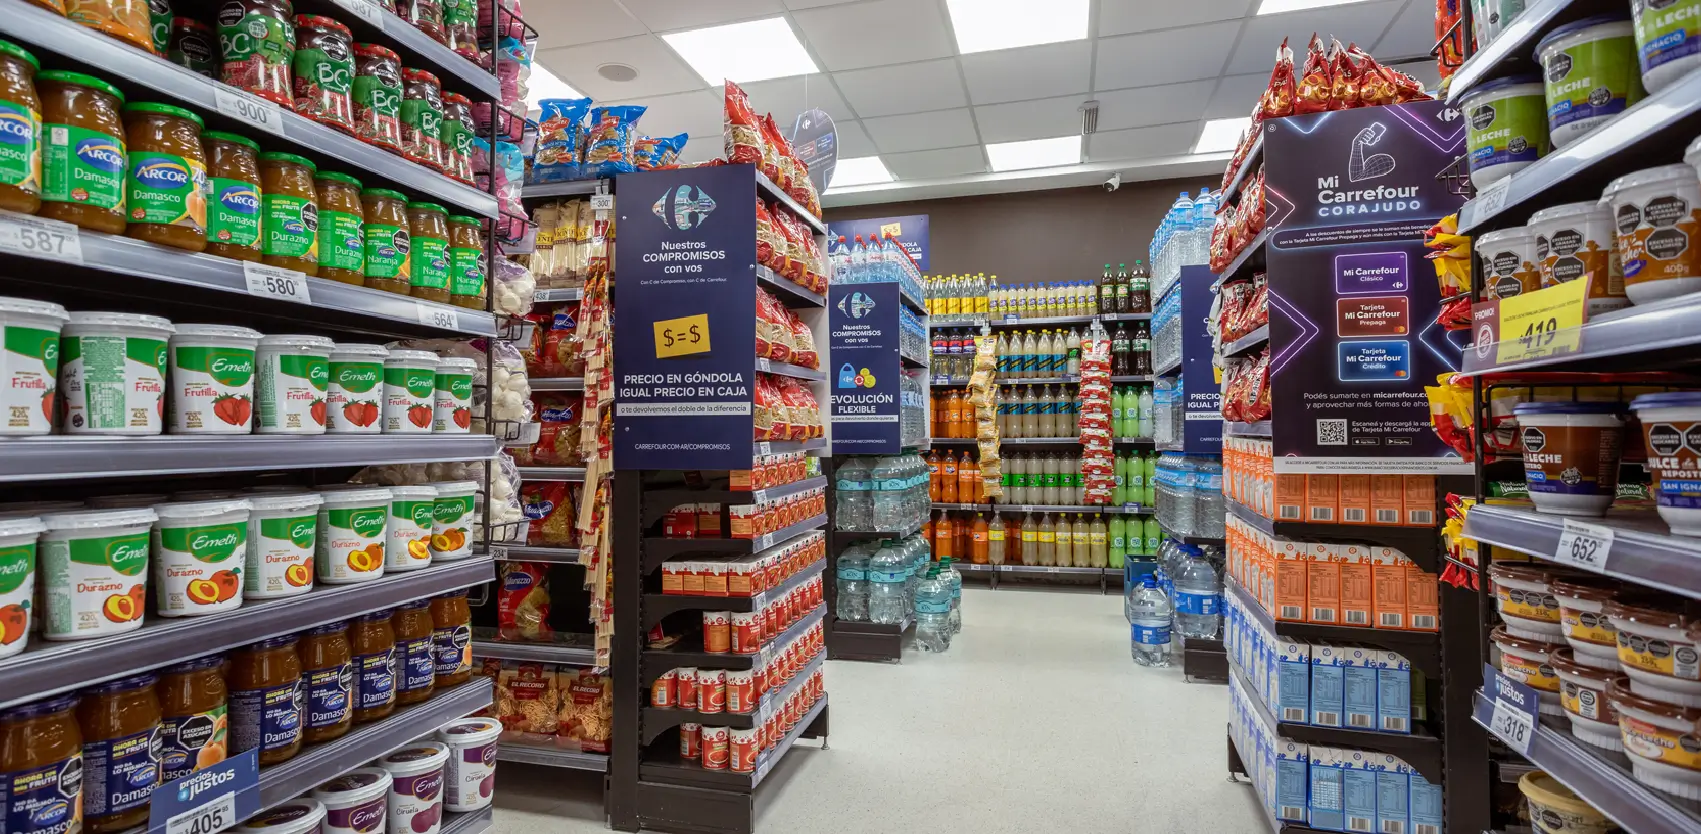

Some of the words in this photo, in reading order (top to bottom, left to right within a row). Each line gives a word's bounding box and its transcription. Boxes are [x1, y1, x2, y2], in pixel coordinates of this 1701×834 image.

[1655, 4, 1701, 28] LECH
[1552, 77, 1591, 98] LECHE
[1476, 128, 1512, 144] LECHE
[77, 143, 123, 167] ARCOR
[74, 168, 120, 189] Damasco
[136, 165, 188, 184] ARCOR
[1317, 175, 1340, 189] Mi
[133, 189, 181, 203] Damasco
[221, 192, 259, 209] ARCOR
[1317, 185, 1420, 204] Carrefour
[1318, 200, 1422, 217] CORAJUDO
[1645, 203, 1672, 212] EXCESO
[1650, 207, 1679, 216] GRASAS
[219, 212, 257, 228] Damasco
[1645, 211, 1685, 221] SATURADAS
[20, 227, 66, 254] 587
[271, 231, 309, 245] Durazno
[1338, 233, 1358, 241] Prepaga
[335, 245, 362, 258] Durazno
[661, 240, 706, 251] Nuestros
[367, 255, 398, 266] Naranja
[642, 250, 726, 263] COMPROMISOS
[422, 266, 447, 279] Naranja
[664, 265, 683, 274] con
[685, 264, 703, 273] vos
[1343, 268, 1354, 277] Mi
[1355, 266, 1400, 276] Carrefour
[1663, 263, 1690, 274] 400g
[456, 276, 480, 287] Naranja
[1360, 303, 1385, 311] Tarjeta
[1344, 312, 1356, 320] Mi
[1356, 310, 1401, 319] Carrefour
[1474, 307, 1495, 320] PROMO!
[434, 312, 453, 328] 564
[1359, 319, 1387, 327] Prepaga
[832, 329, 882, 338] COMPROMISOS
[1524, 317, 1557, 349] 419
[1361, 347, 1386, 356] Tarjeta
[1346, 355, 1357, 363] Mi
[1357, 353, 1402, 362] Carrefour
[211, 357, 252, 373] Emeth
[1362, 362, 1387, 370] Crédito
[339, 371, 376, 382] Emeth
[624, 374, 664, 385] PRECIO
[666, 373, 682, 384] EN
[684, 371, 743, 383] GÓNDOLA
[12, 377, 46, 390] Frutilla
[135, 382, 161, 393] Frutilla
[184, 387, 218, 398] Frutilla
[620, 387, 651, 398] IGUAL
[653, 387, 695, 397] PRECIO
[698, 386, 714, 397] EN
[717, 386, 748, 397] CAJA
[830, 392, 893, 404] EVOLUCIÓN
[1190, 393, 1221, 401] PRECIO
[1303, 392, 1328, 400] Podés
[1373, 391, 1428, 399] micarrefour.co
[632, 405, 671, 413] devolvemos
[713, 404, 747, 412] diferencia
[838, 405, 877, 414] FLEXIBLE
[1312, 400, 1355, 409] aprovechar
[1356, 400, 1373, 408] más
[1374, 400, 1400, 408] formas
[1361, 426, 1384, 434] Tarjeta
[1384, 420, 1412, 428] descargá
[634, 443, 731, 451] CARREFOUR.COM.AR/COMPROMISOS
[1528, 453, 1563, 464] LECHE
[1662, 482, 1679, 490] SAN
[433, 503, 464, 516] Emeth
[353, 515, 385, 529] Emeth
[192, 529, 237, 550] Emeth
[1570, 535, 1597, 563] 652
[265, 554, 300, 564] Durazno
[166, 568, 204, 577] Durazno
[77, 582, 123, 593] Durazno
[579, 685, 600, 694] RECORD
[1499, 682, 1525, 706] justos
[311, 707, 347, 722] Damasco
[182, 726, 204, 735] EXCESO
[1504, 715, 1525, 742] 318
[112, 738, 137, 752] AHORA
[125, 741, 149, 755] FRUTA
[13, 773, 44, 786] AHORA
[28, 775, 57, 789] FRUTA
[130, 768, 156, 785] ARCOR
[179, 770, 213, 791] precios
[464, 773, 486, 783] Ciruela
[187, 767, 236, 801] justos
[112, 780, 159, 805] Damasco
[34, 806, 67, 823] ARCOR
[396, 805, 419, 816] Ciruela
